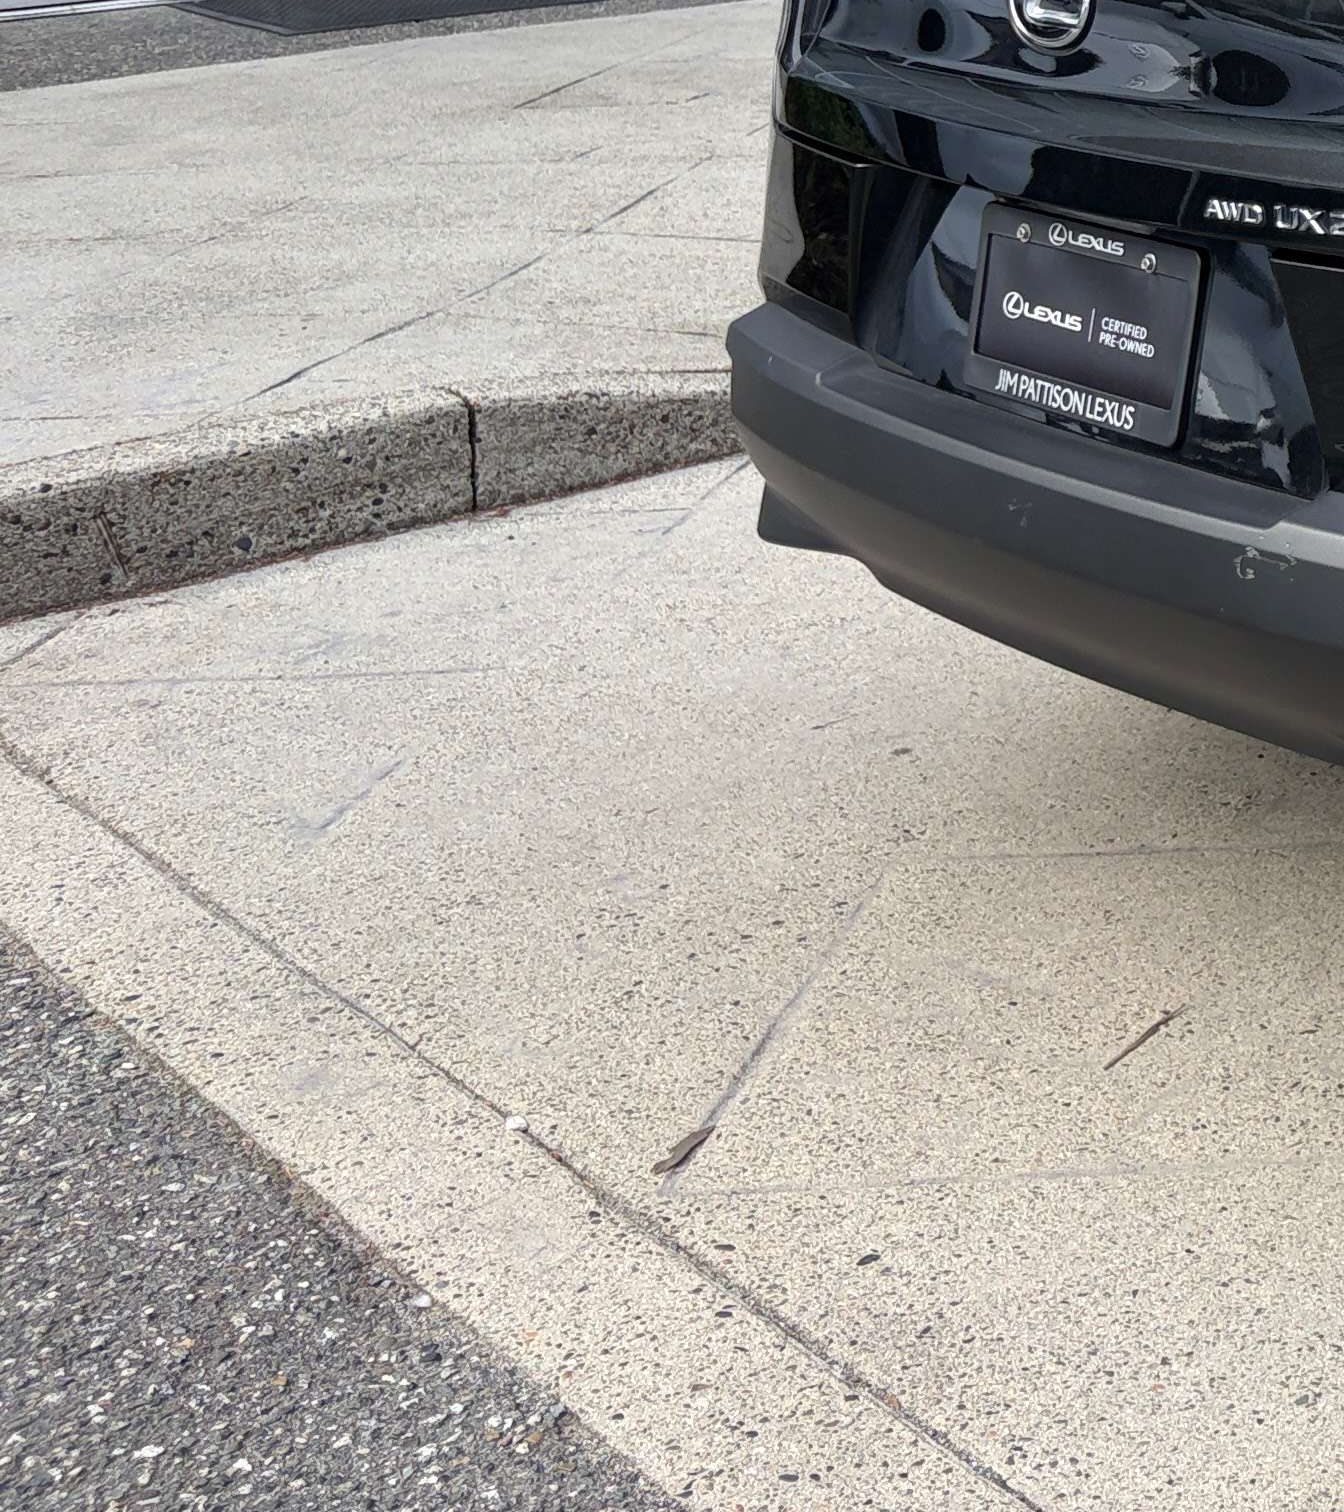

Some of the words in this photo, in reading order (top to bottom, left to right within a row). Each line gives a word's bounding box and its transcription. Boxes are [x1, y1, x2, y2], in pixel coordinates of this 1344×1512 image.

[1203, 198, 1263, 225] AWD
[1068, 232, 1125, 256] LEXUS
[1023, 301, 1083, 332] LEXUS
[1101, 316, 1148, 340] CERTIFIED
[1098, 331, 1155, 359] PRE-OWNED
[994, 368, 1019, 396] JIM
[1020, 374, 1086, 417] PATTISON
[1085, 393, 1136, 430] LEXUS
